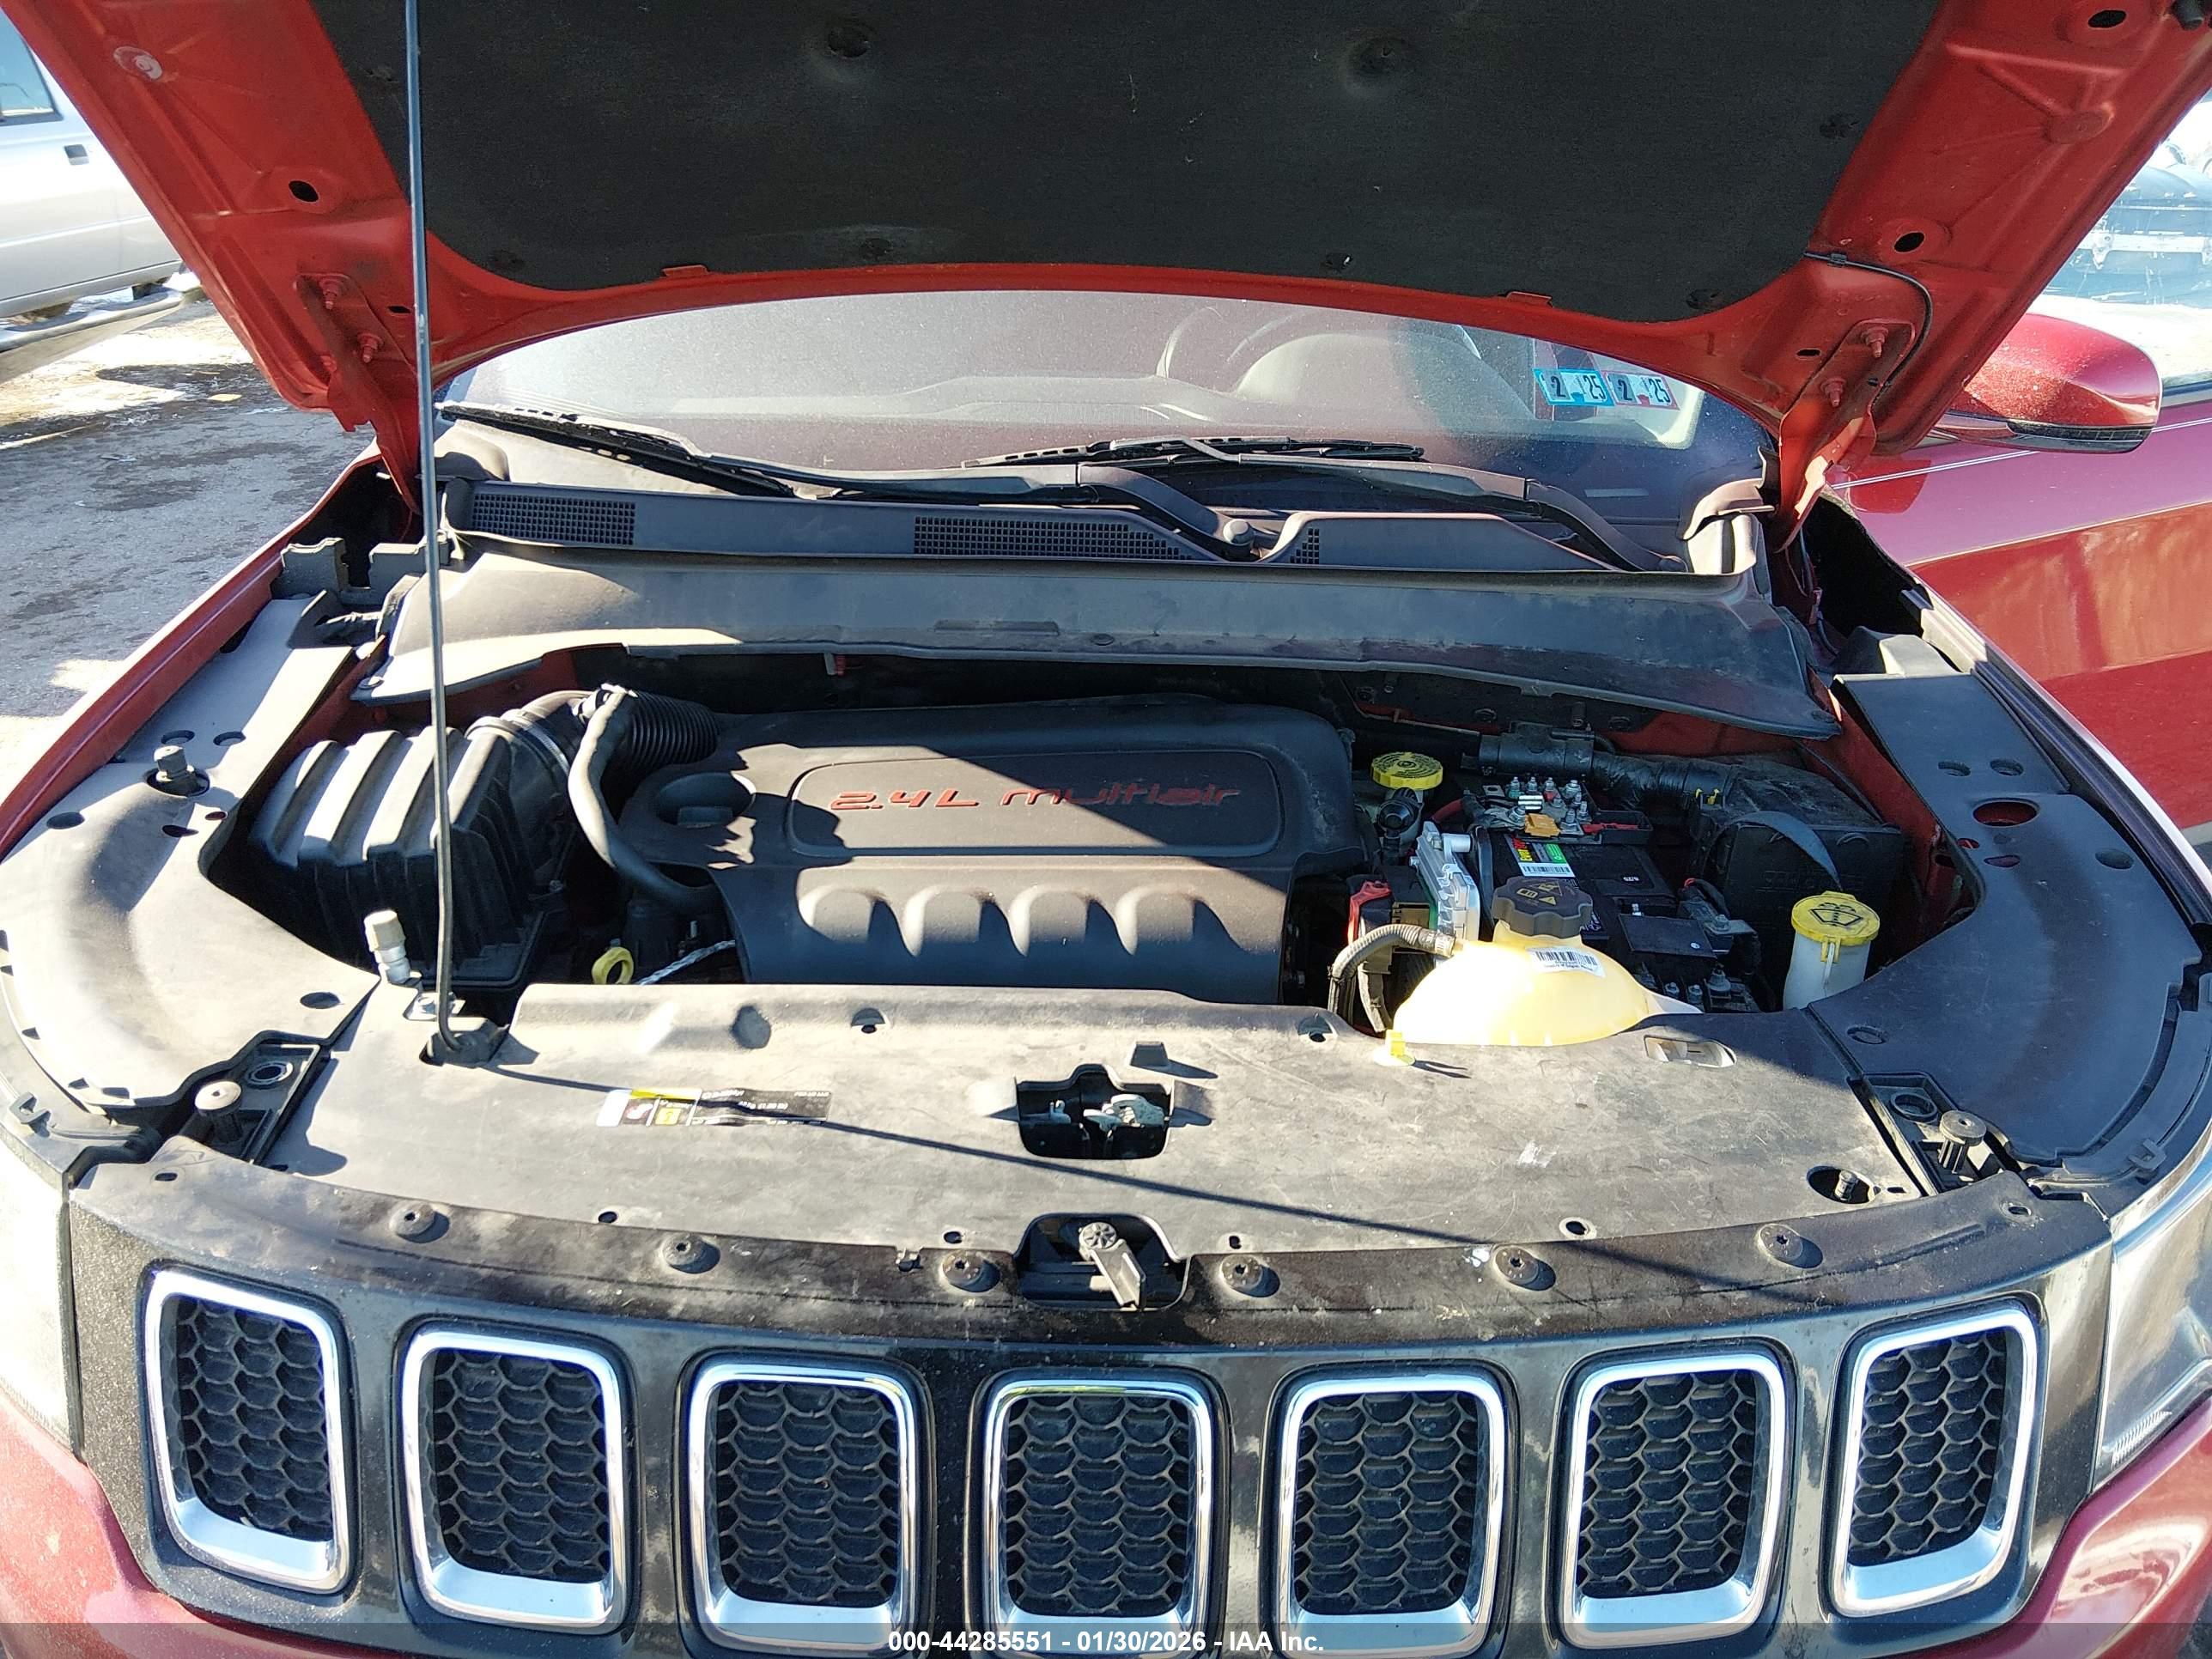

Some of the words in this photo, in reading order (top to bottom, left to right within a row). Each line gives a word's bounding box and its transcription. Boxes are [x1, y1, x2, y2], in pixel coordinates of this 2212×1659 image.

[1551, 375, 1566, 398] 2
[1583, 374, 1606, 401] 25
[1618, 379, 1632, 402] 2
[1649, 378, 1671, 404] 25
[830, 789, 980, 811] 2.4L
